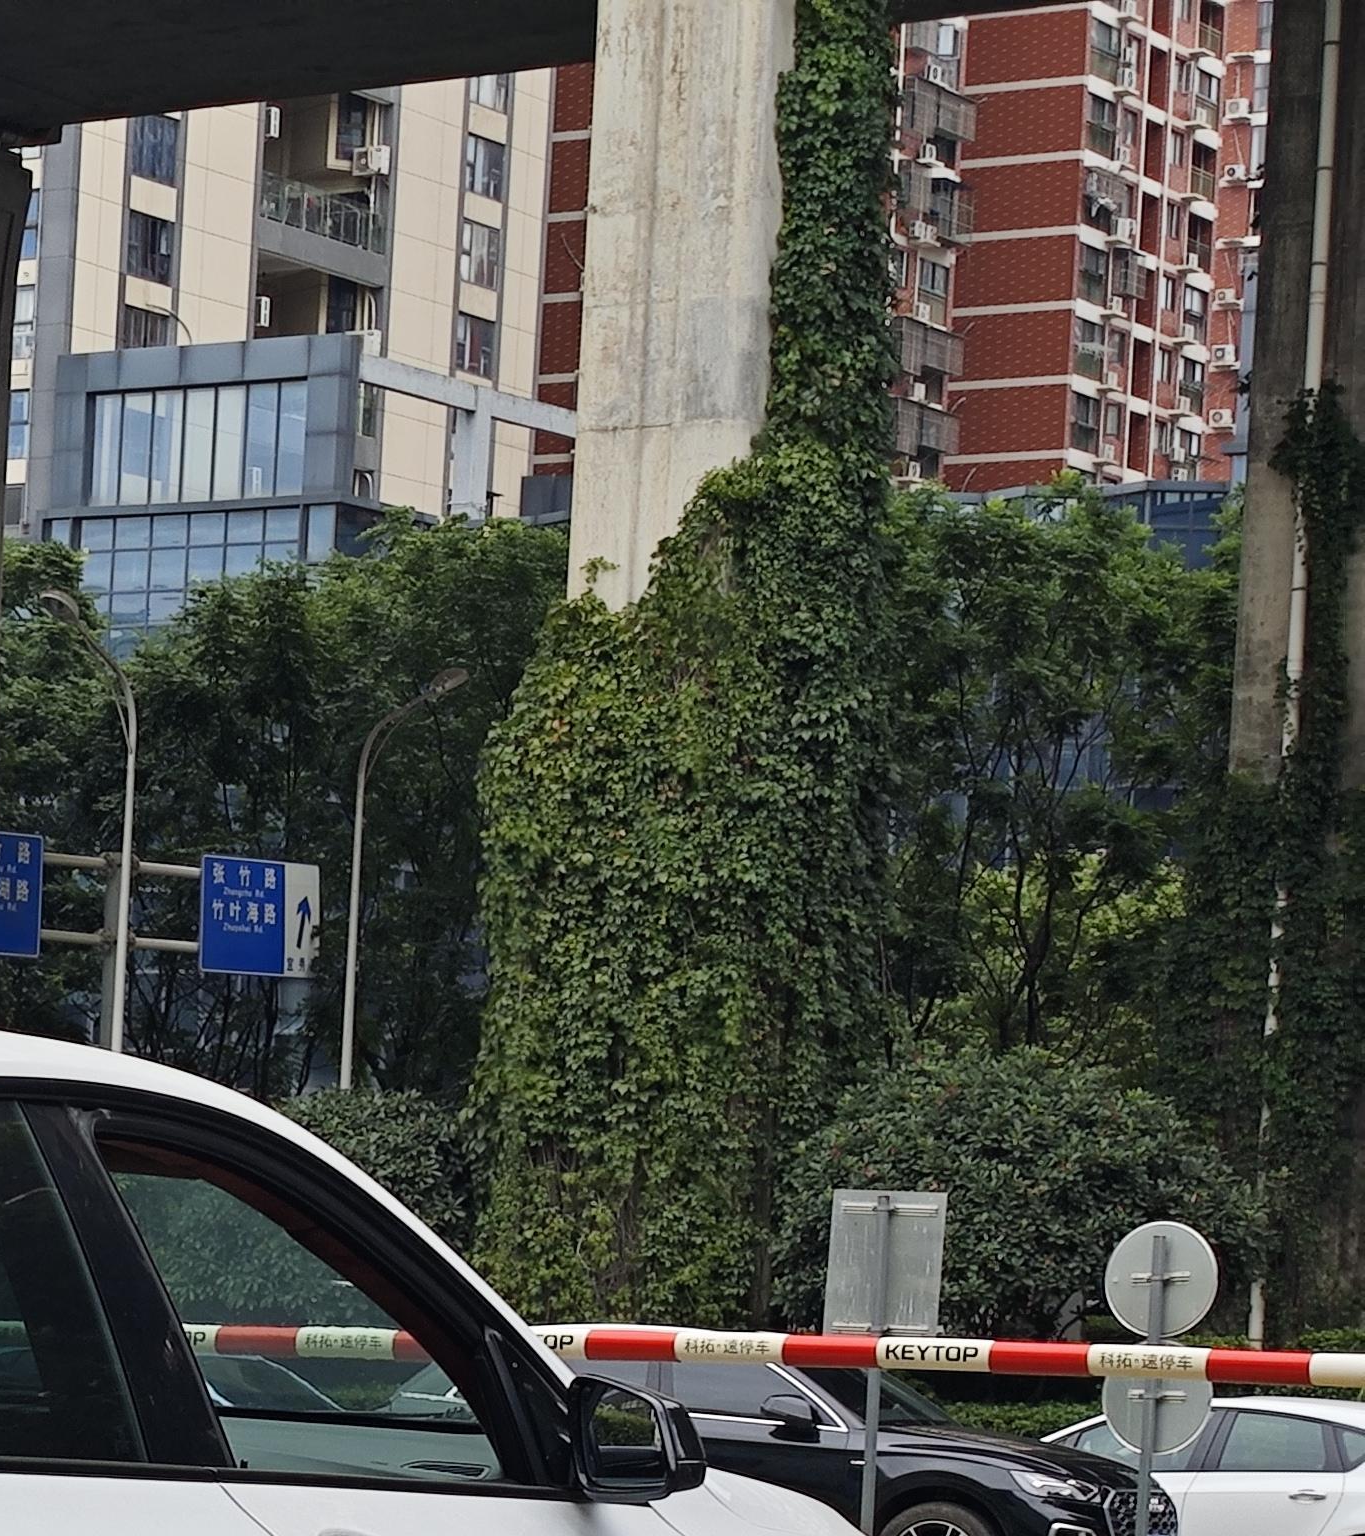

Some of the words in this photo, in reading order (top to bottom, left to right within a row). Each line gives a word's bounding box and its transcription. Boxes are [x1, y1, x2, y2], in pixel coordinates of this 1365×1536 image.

[212, 862, 276, 890] 张竹路
[211, 899, 276, 925] 竹叶海路
[885, 1344, 979, 1363] KEYTOP
